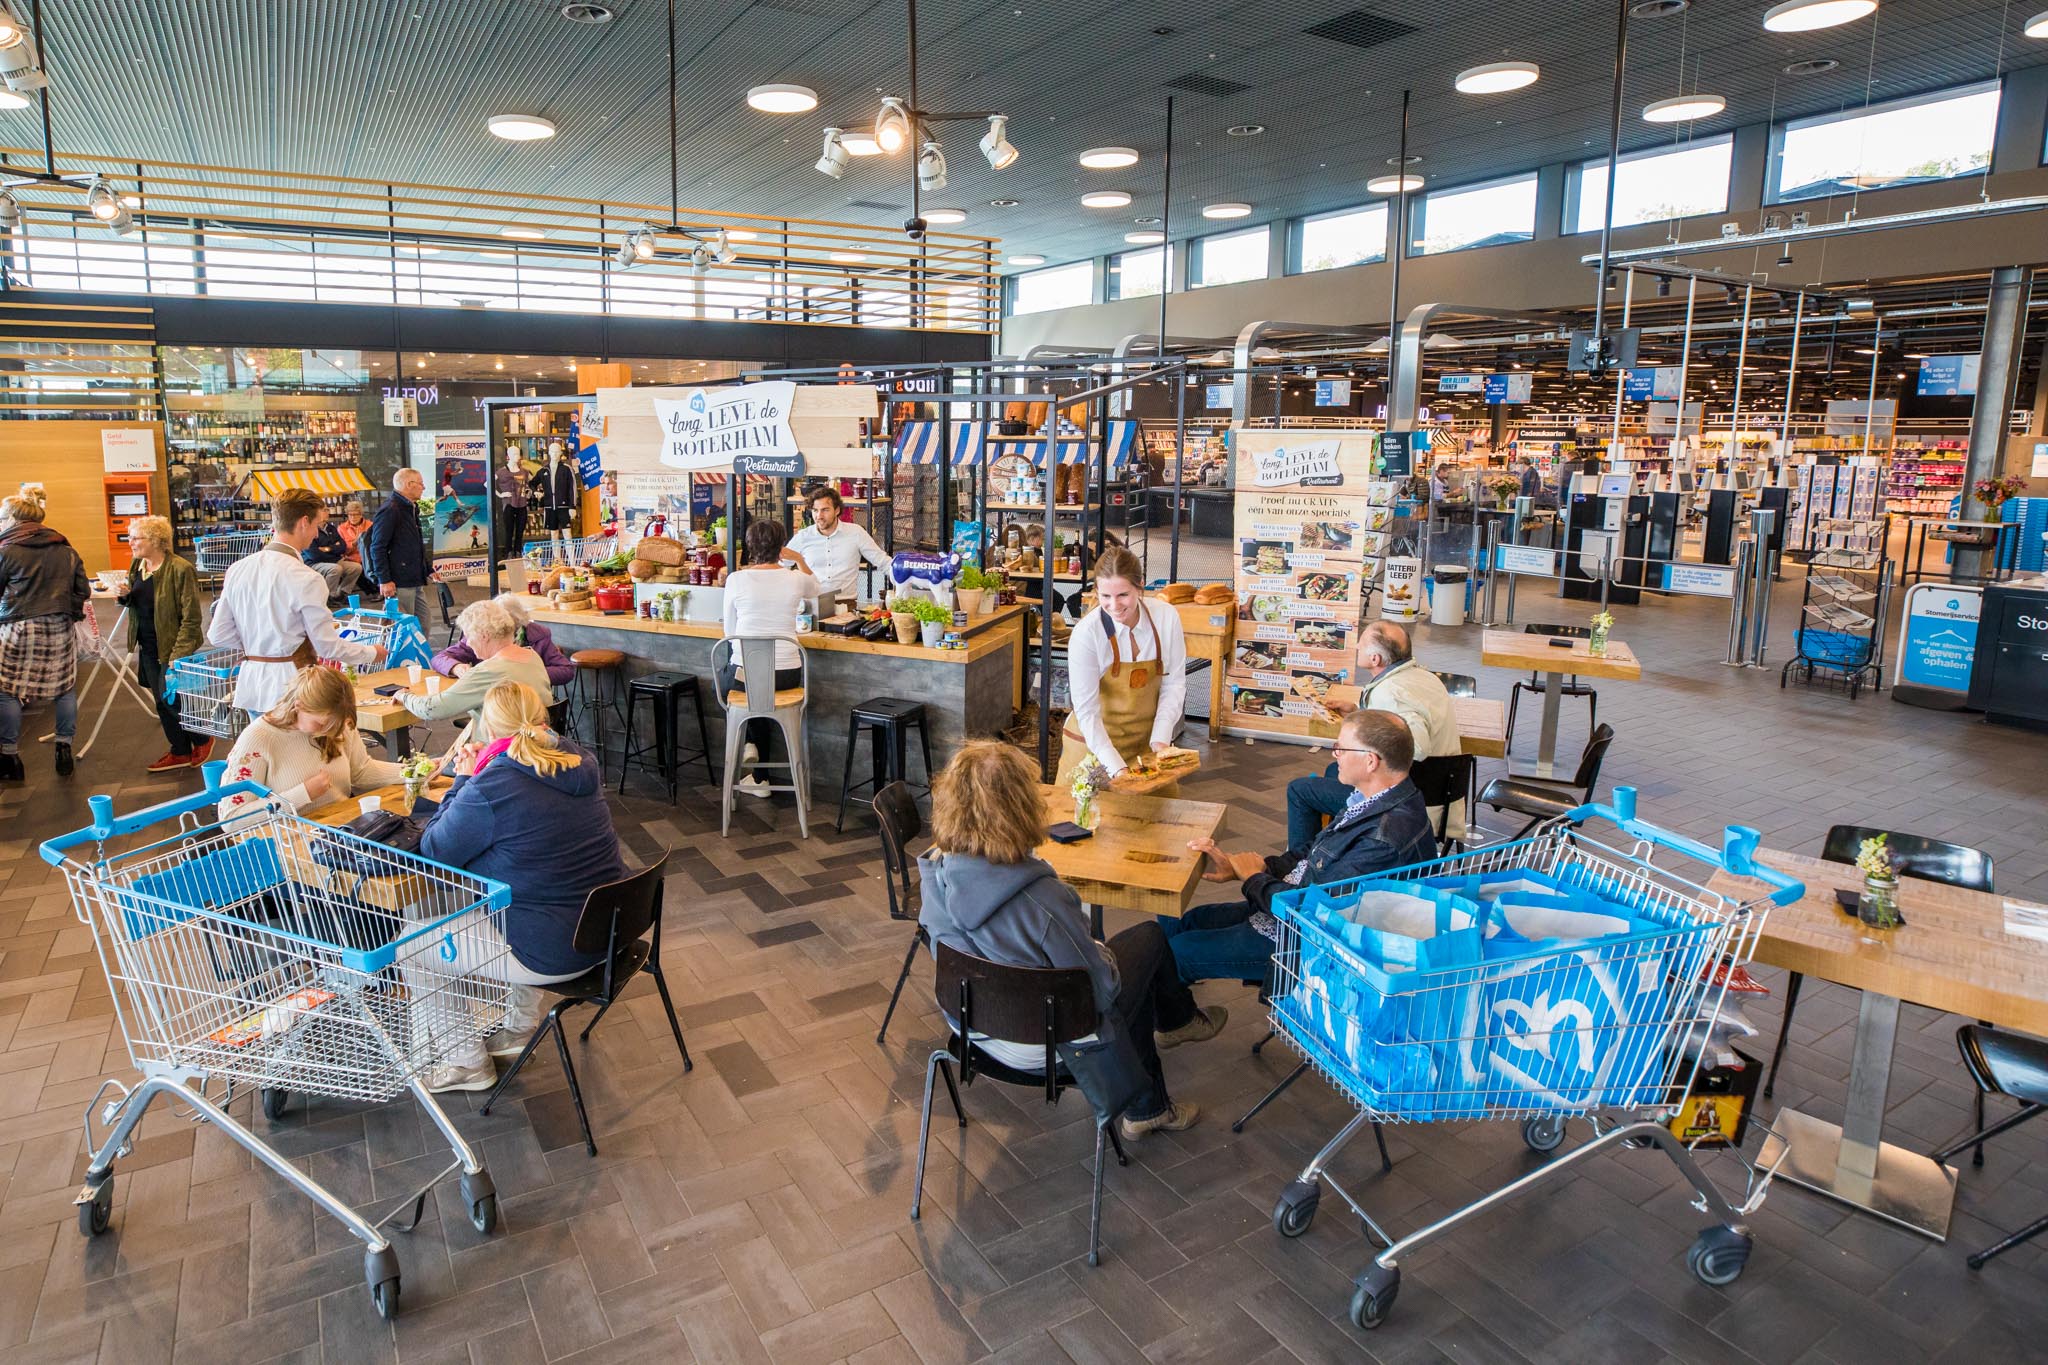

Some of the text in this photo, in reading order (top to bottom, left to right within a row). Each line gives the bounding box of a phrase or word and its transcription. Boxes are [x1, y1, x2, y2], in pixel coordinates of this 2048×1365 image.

[668, 399, 779, 437] Lang LEVE de
[673, 424, 778, 456] BOTERHAM
[1318, 448, 1330, 458] de
[745, 456, 799, 473] Restaurant
[1262, 460, 1329, 481] BOTERHAM
[1261, 496, 1285, 505] Proef
[1303, 498, 1338, 506] GRATIS
[1267, 507, 1284, 515] van
[1286, 508, 1309, 516] onze
[1312, 508, 1351, 518] specials!
[442, 560, 486, 571] INTERSPORT
[903, 560, 941, 571] BEEMSTER
[439, 567, 486, 578] NDHOVEN-CITY
[1390, 572, 1413, 580] LEEG?
[1926, 610, 1979, 621] Stomerijservice
[1920, 647, 1962, 660] afgeven
[1924, 658, 1968, 670] ophalen
